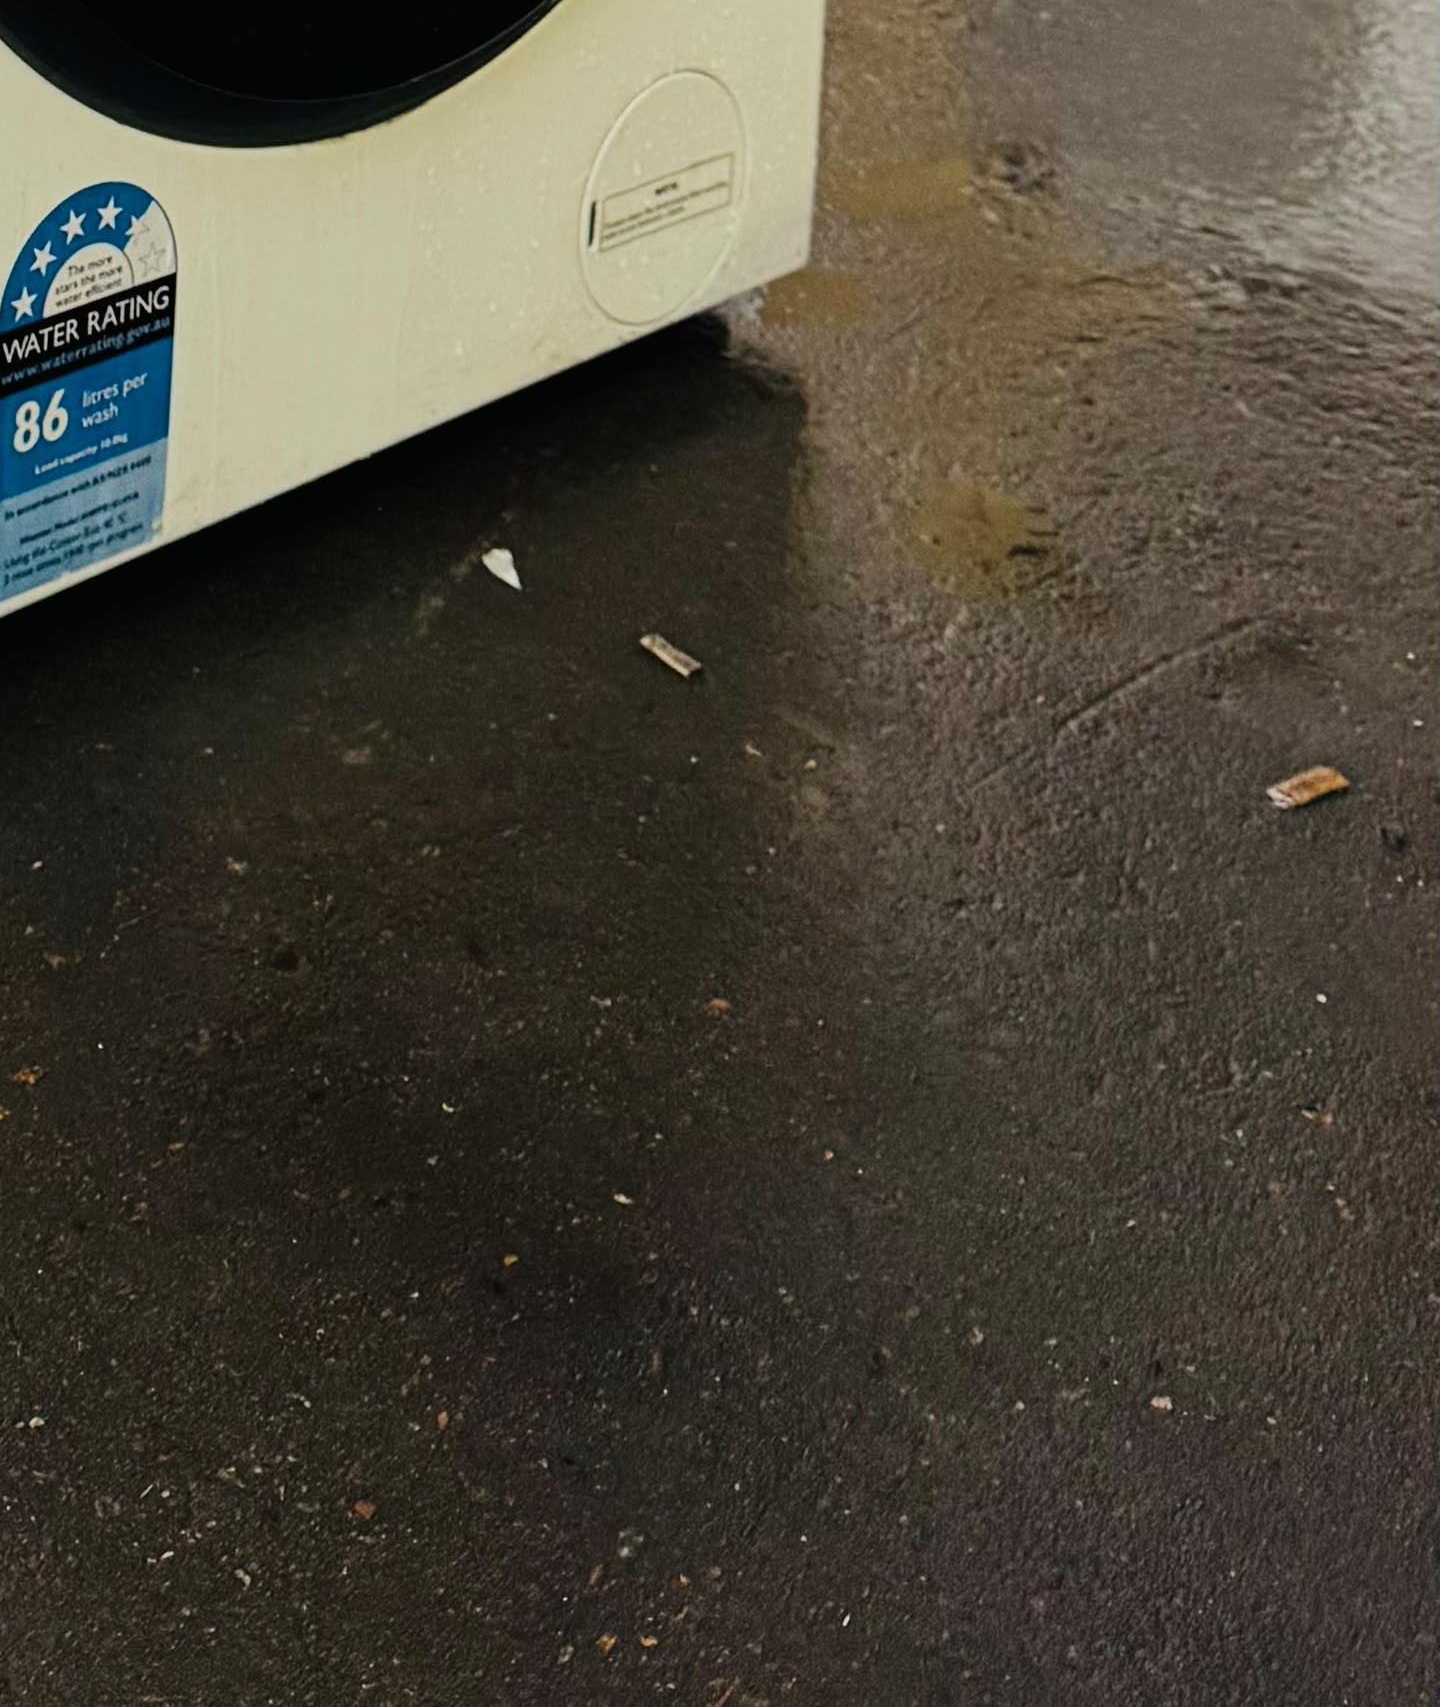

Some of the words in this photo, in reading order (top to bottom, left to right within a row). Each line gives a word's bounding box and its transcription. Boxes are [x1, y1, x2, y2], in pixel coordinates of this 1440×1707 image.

[87, 256, 113, 272] more
[2, 318, 80, 364] WATER
[87, 285, 170, 336] RATING
[82, 383, 119, 408] litres
[122, 372, 148, 398] per
[13, 388, 69, 453] 86
[82, 402, 119, 428] wash
